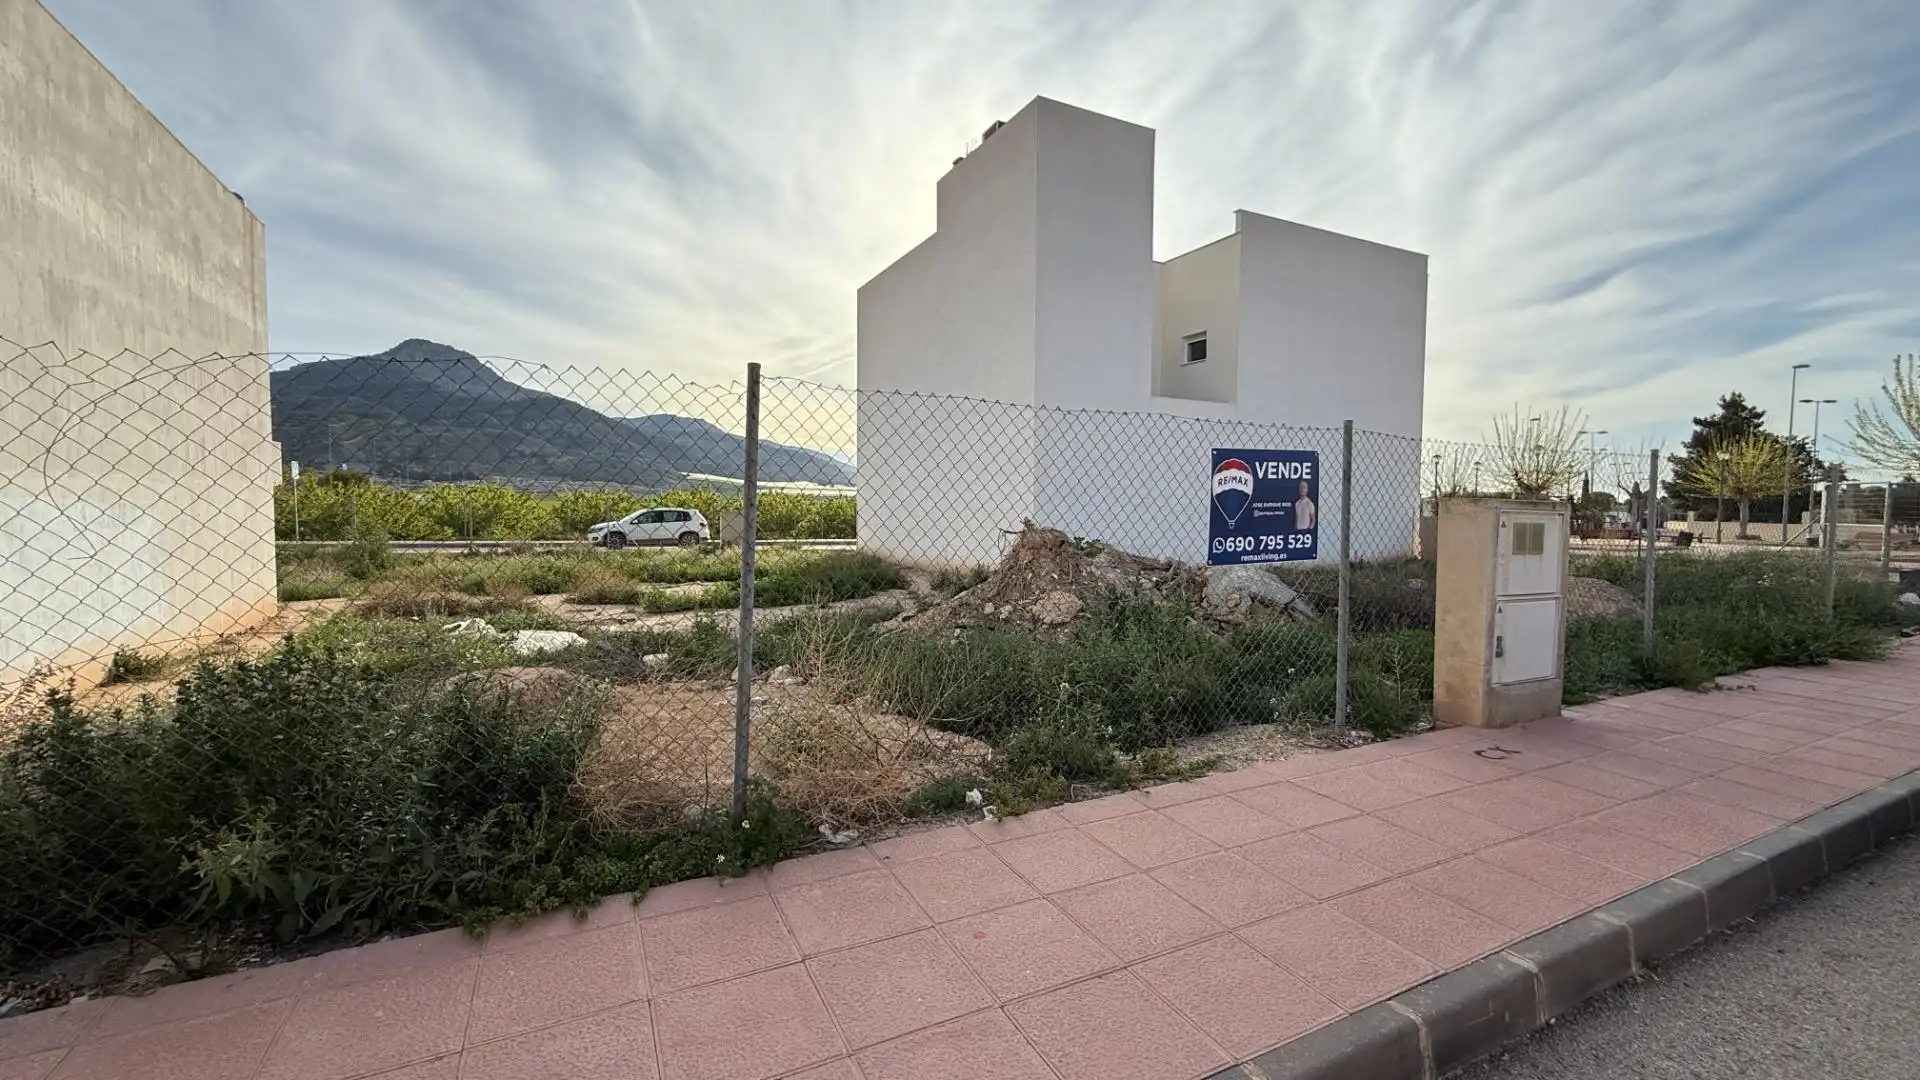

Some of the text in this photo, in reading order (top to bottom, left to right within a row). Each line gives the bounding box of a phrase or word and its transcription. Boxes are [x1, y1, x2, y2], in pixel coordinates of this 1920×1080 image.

[1255, 461, 1312, 479] VENDE
[1217, 475, 1249, 488] RE/MAX
[1226, 534, 1312, 552] 690 795 529
[1240, 552, 1287, 562] remaxliving.es
